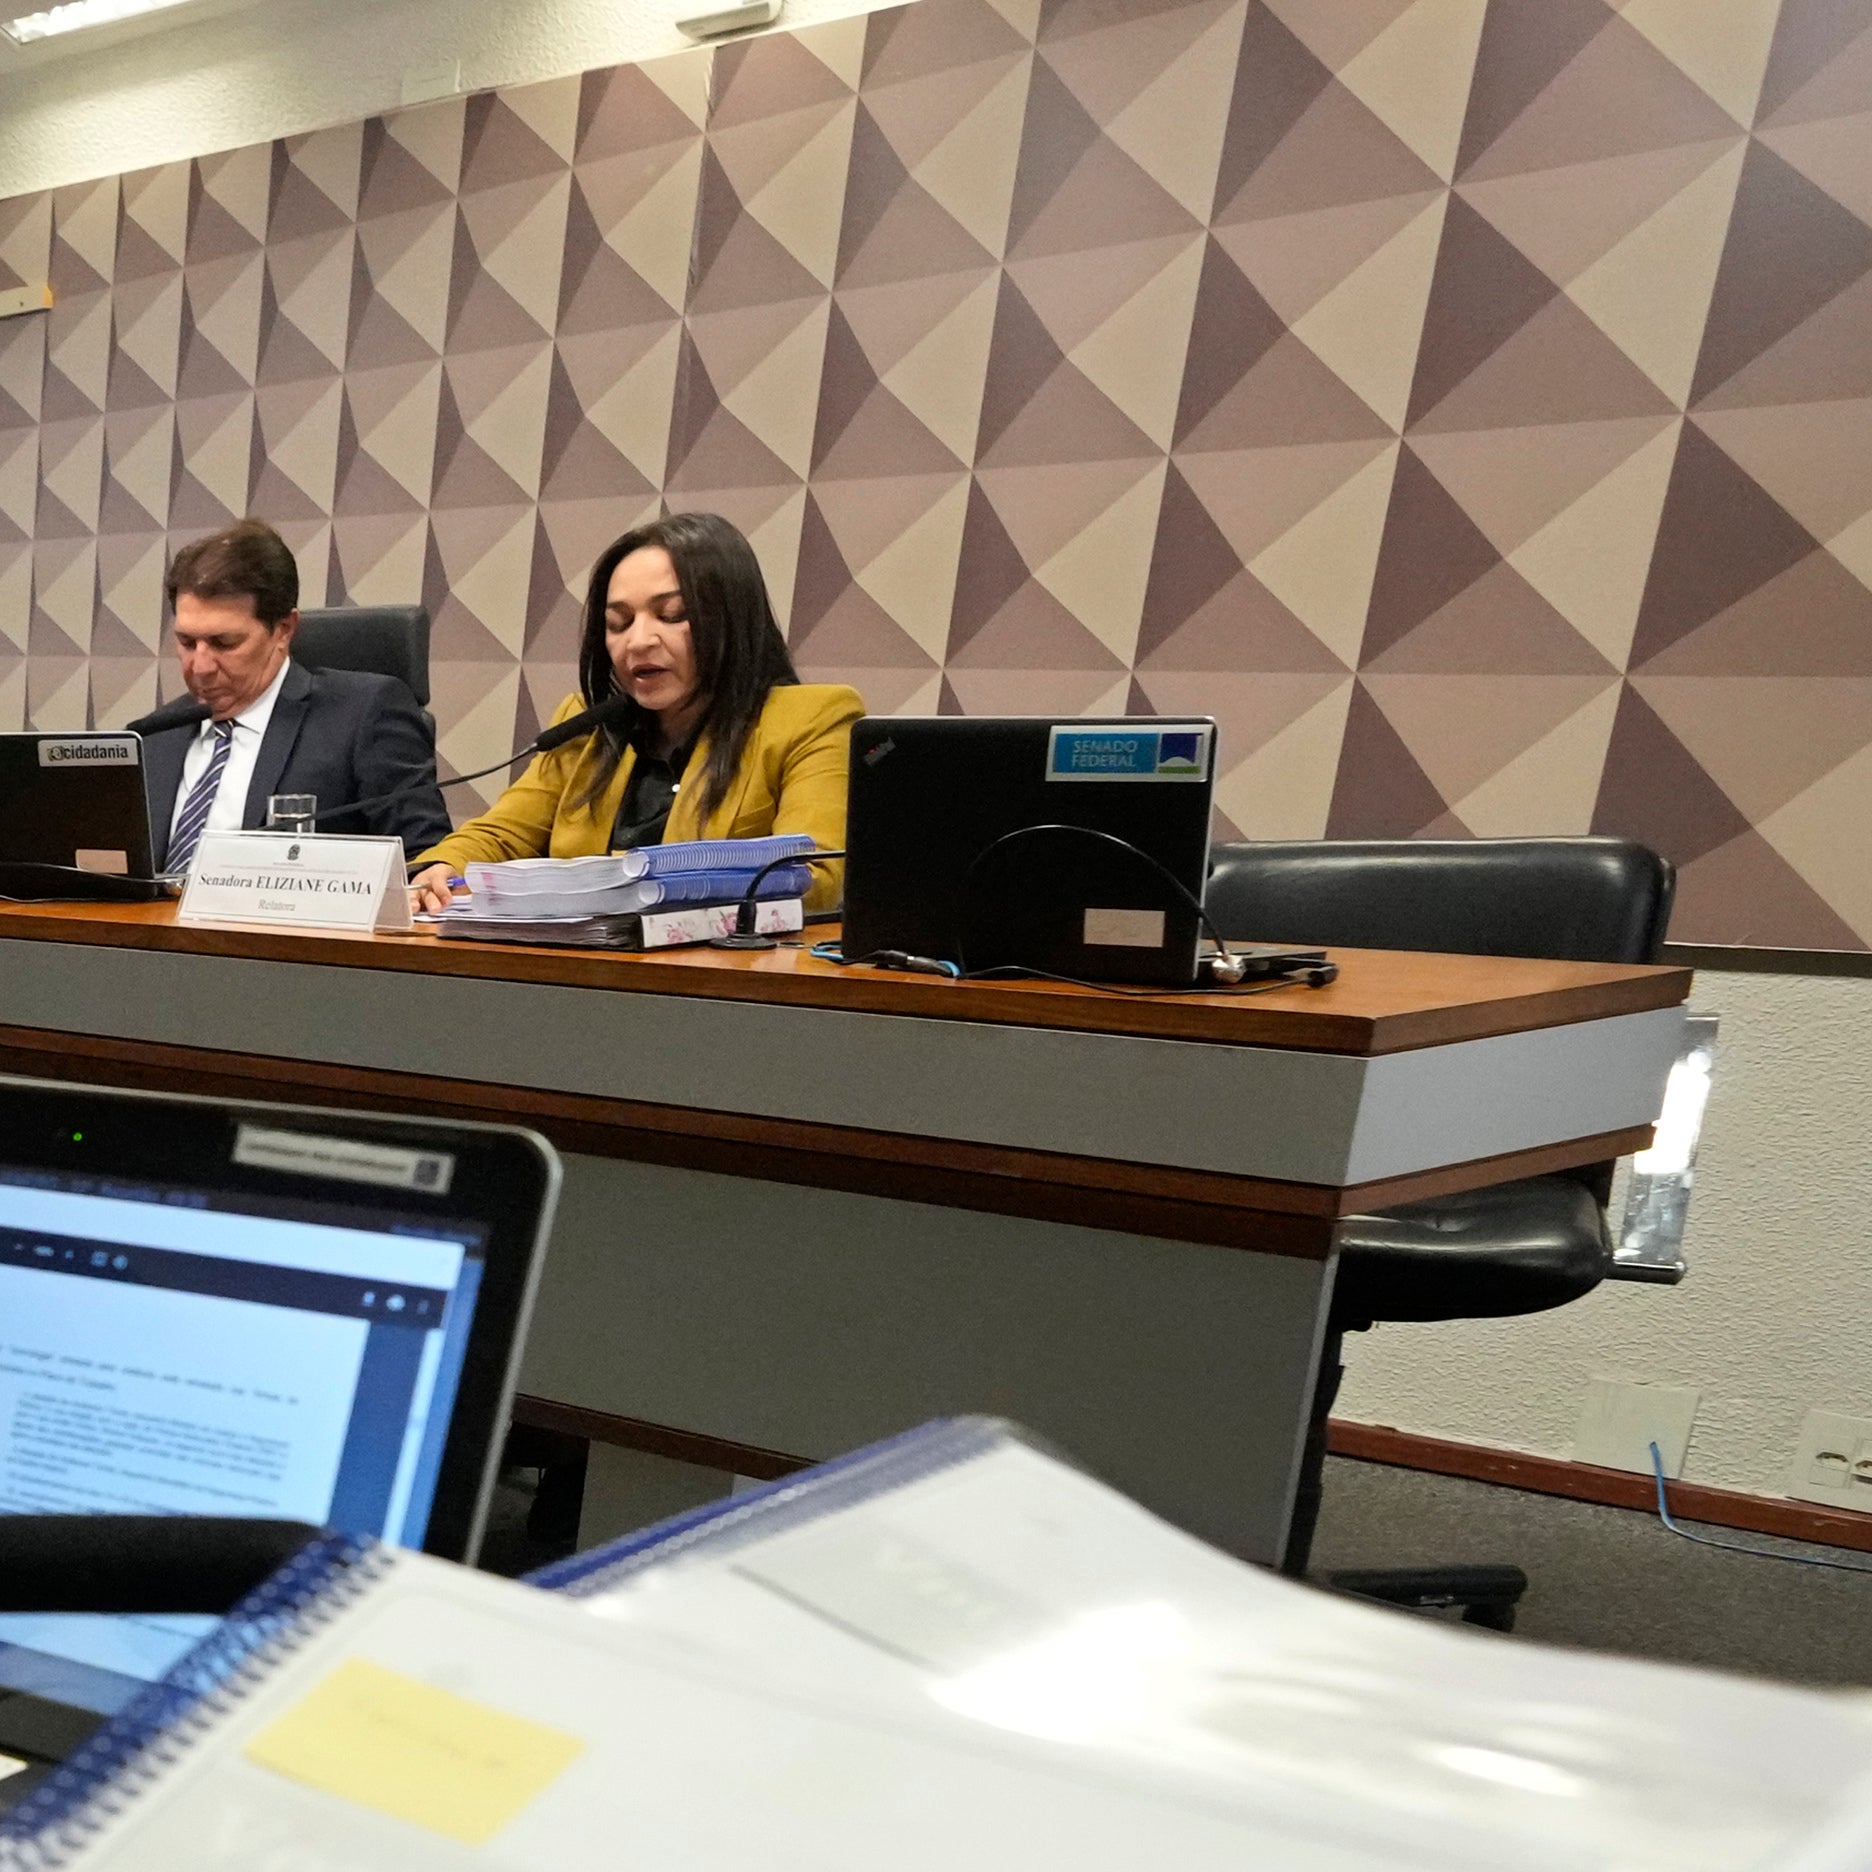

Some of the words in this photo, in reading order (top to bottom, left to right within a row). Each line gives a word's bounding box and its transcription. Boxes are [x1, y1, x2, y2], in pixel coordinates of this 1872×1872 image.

[1072, 739, 1139, 753] SENADO
[1071, 754, 1137, 768] FEDERAL
[198, 873, 253, 889] Senadora
[255, 875, 324, 893] ELIZIANE
[326, 879, 373, 895] GAMA
[258, 898, 297, 912] Relatora
